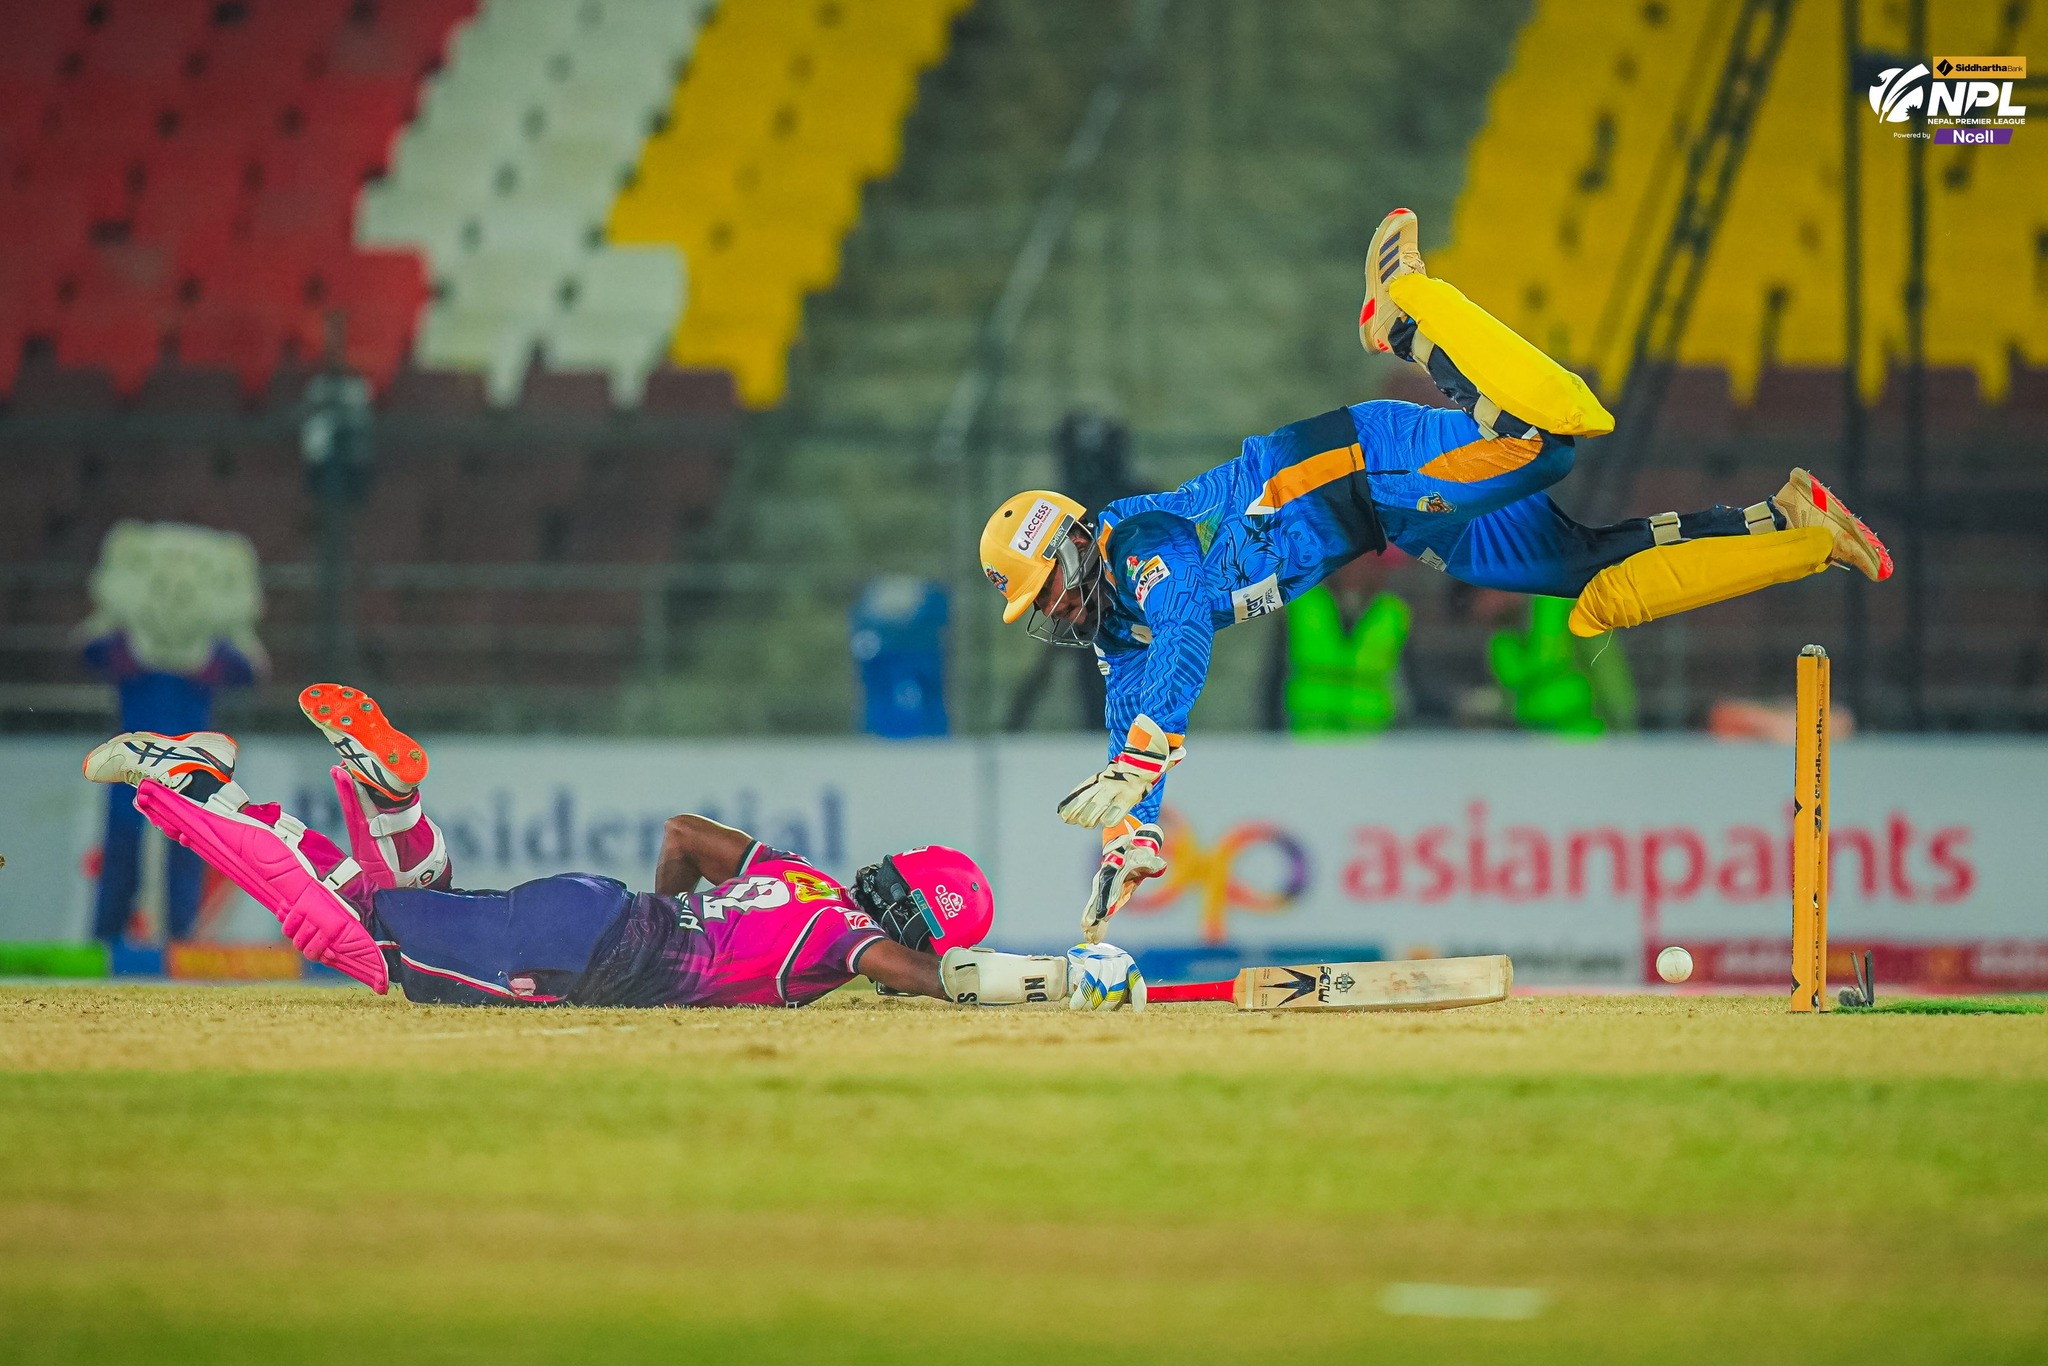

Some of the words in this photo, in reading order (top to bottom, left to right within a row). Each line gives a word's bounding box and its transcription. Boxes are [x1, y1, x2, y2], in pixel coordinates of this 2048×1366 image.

[1024, 504, 1049, 539] ACCESS
[913, 892, 928, 910] AIR
[935, 884, 959, 918] Cloud
